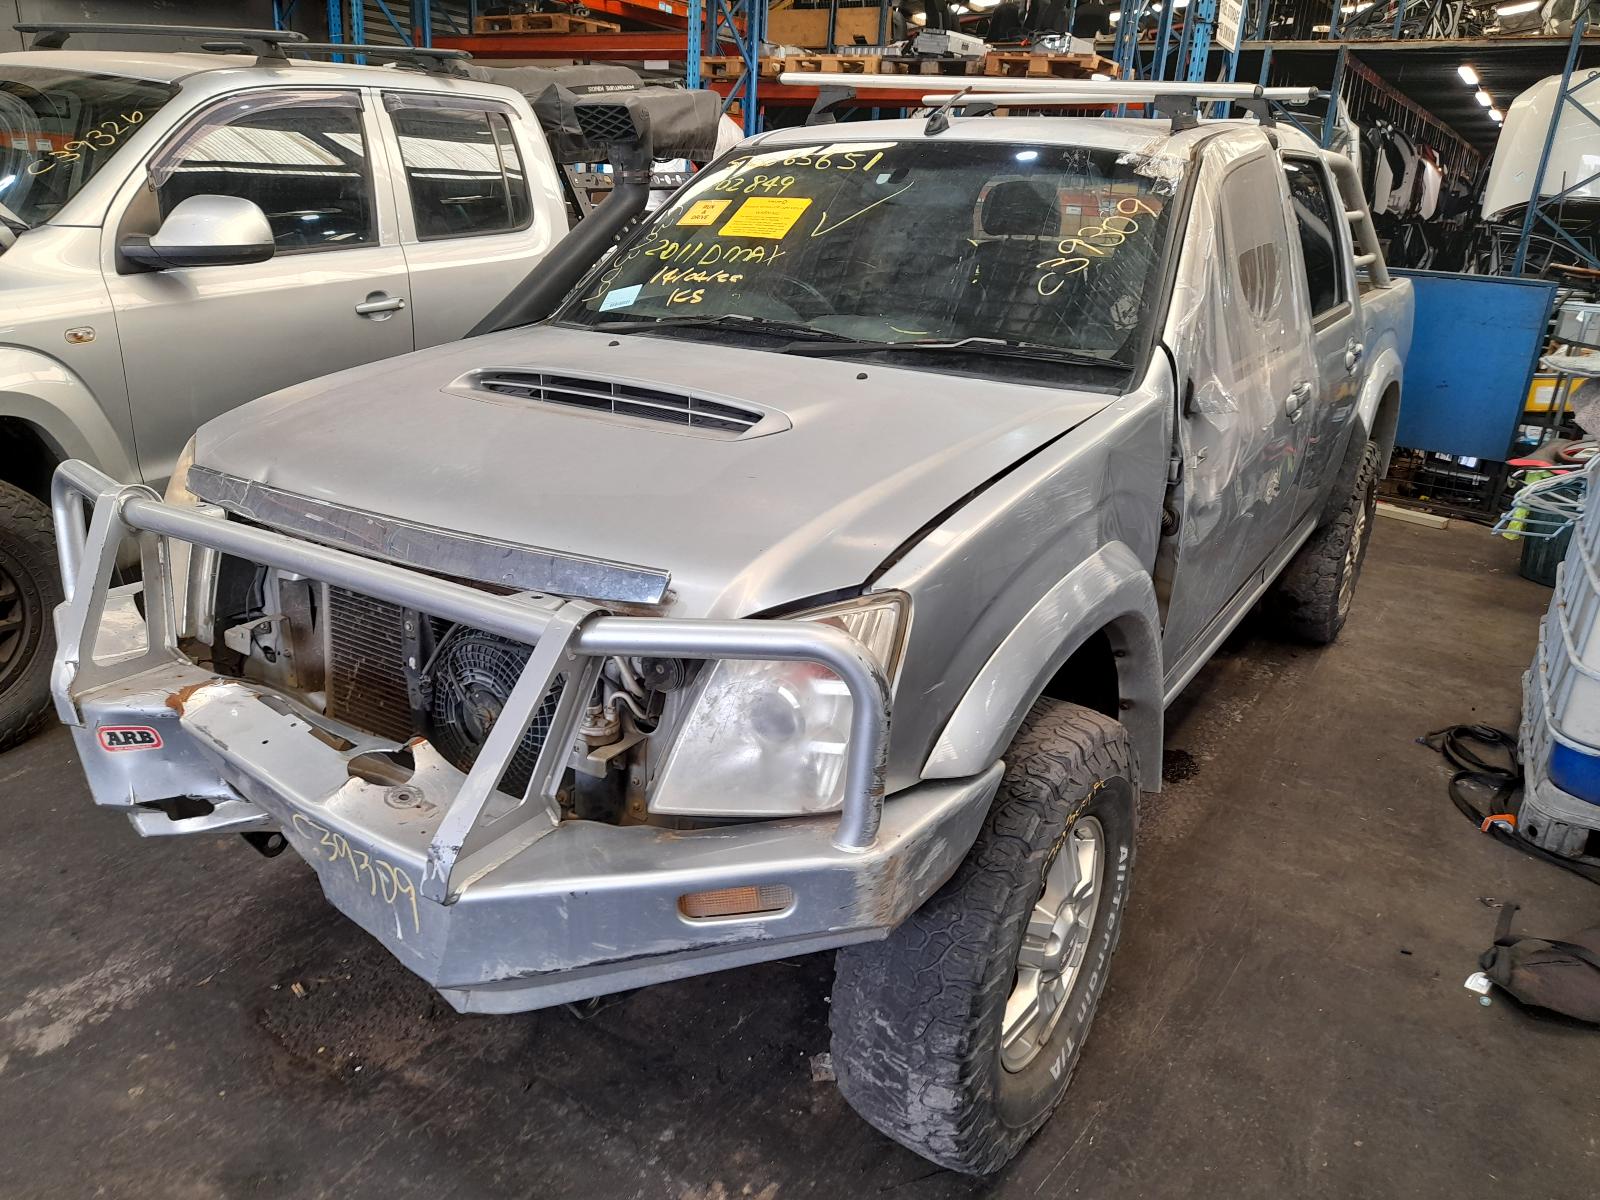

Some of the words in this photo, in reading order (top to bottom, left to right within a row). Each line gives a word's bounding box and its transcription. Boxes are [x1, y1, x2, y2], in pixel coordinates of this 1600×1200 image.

[27, 111, 143, 175] C39326
[644, 239, 703, 264] 2011
[1036, 198, 1158, 295] C39309
[106, 730, 155, 746] ARB
[292, 813, 420, 934] C39309
